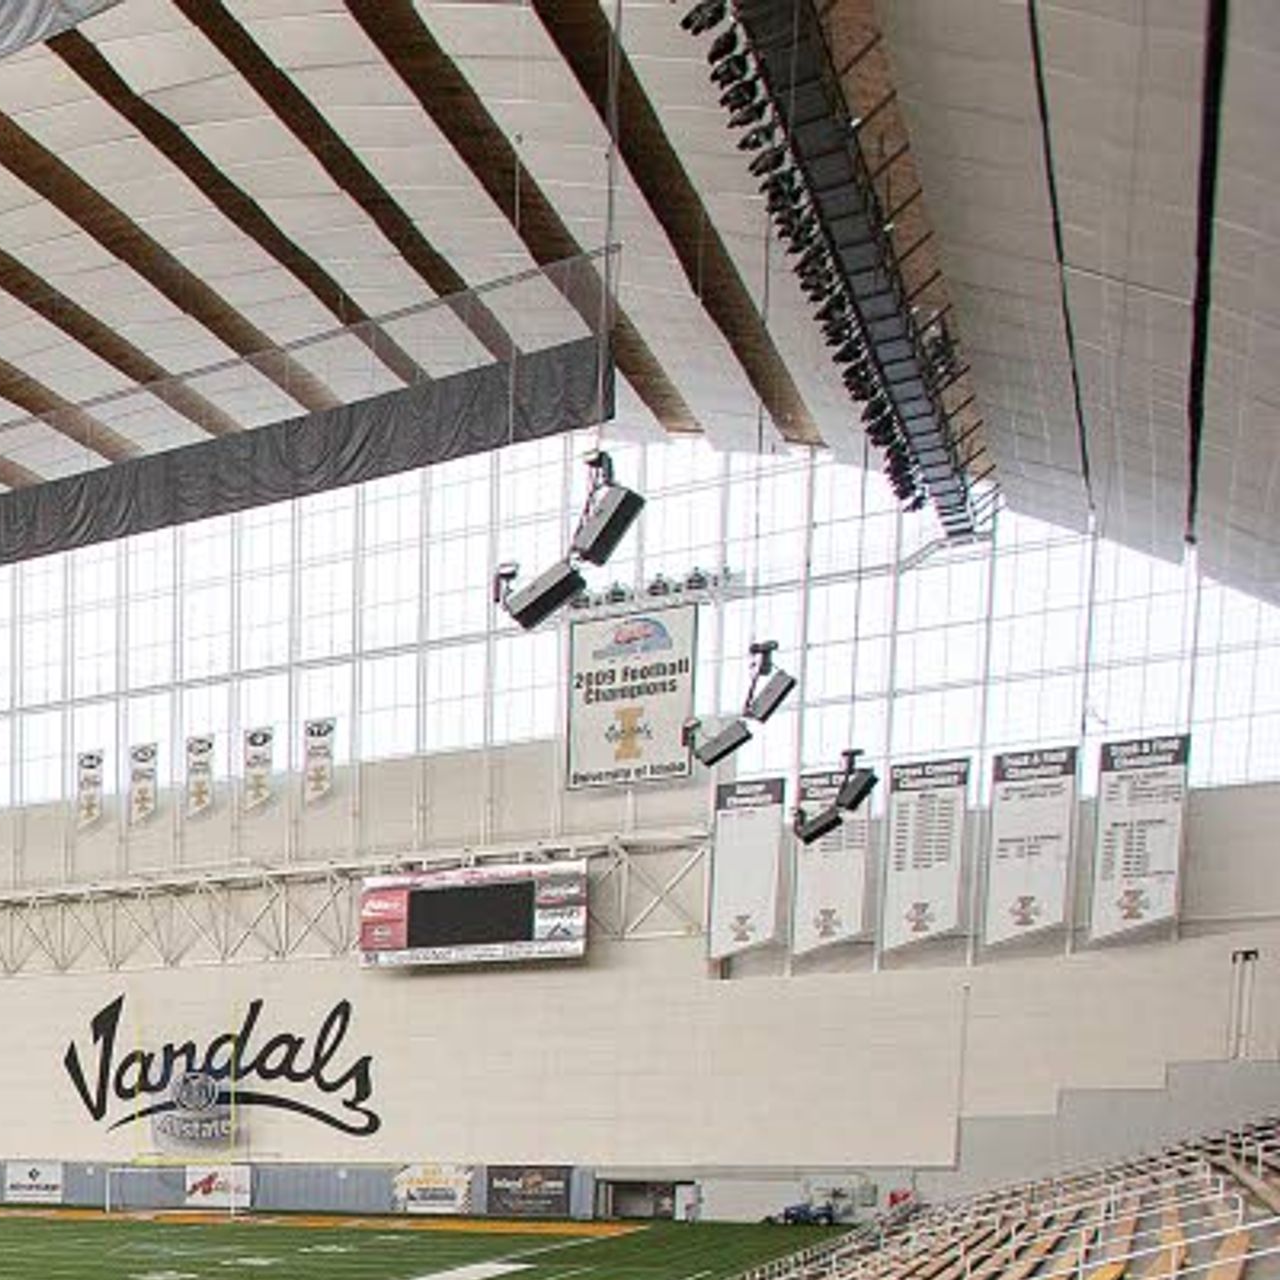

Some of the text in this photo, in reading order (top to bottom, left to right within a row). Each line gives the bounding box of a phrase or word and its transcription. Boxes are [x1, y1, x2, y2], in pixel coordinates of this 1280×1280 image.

[621, 656, 690, 682] Football
[584, 679, 677, 704] Champions
[64, 993, 380, 1136] Vandals
